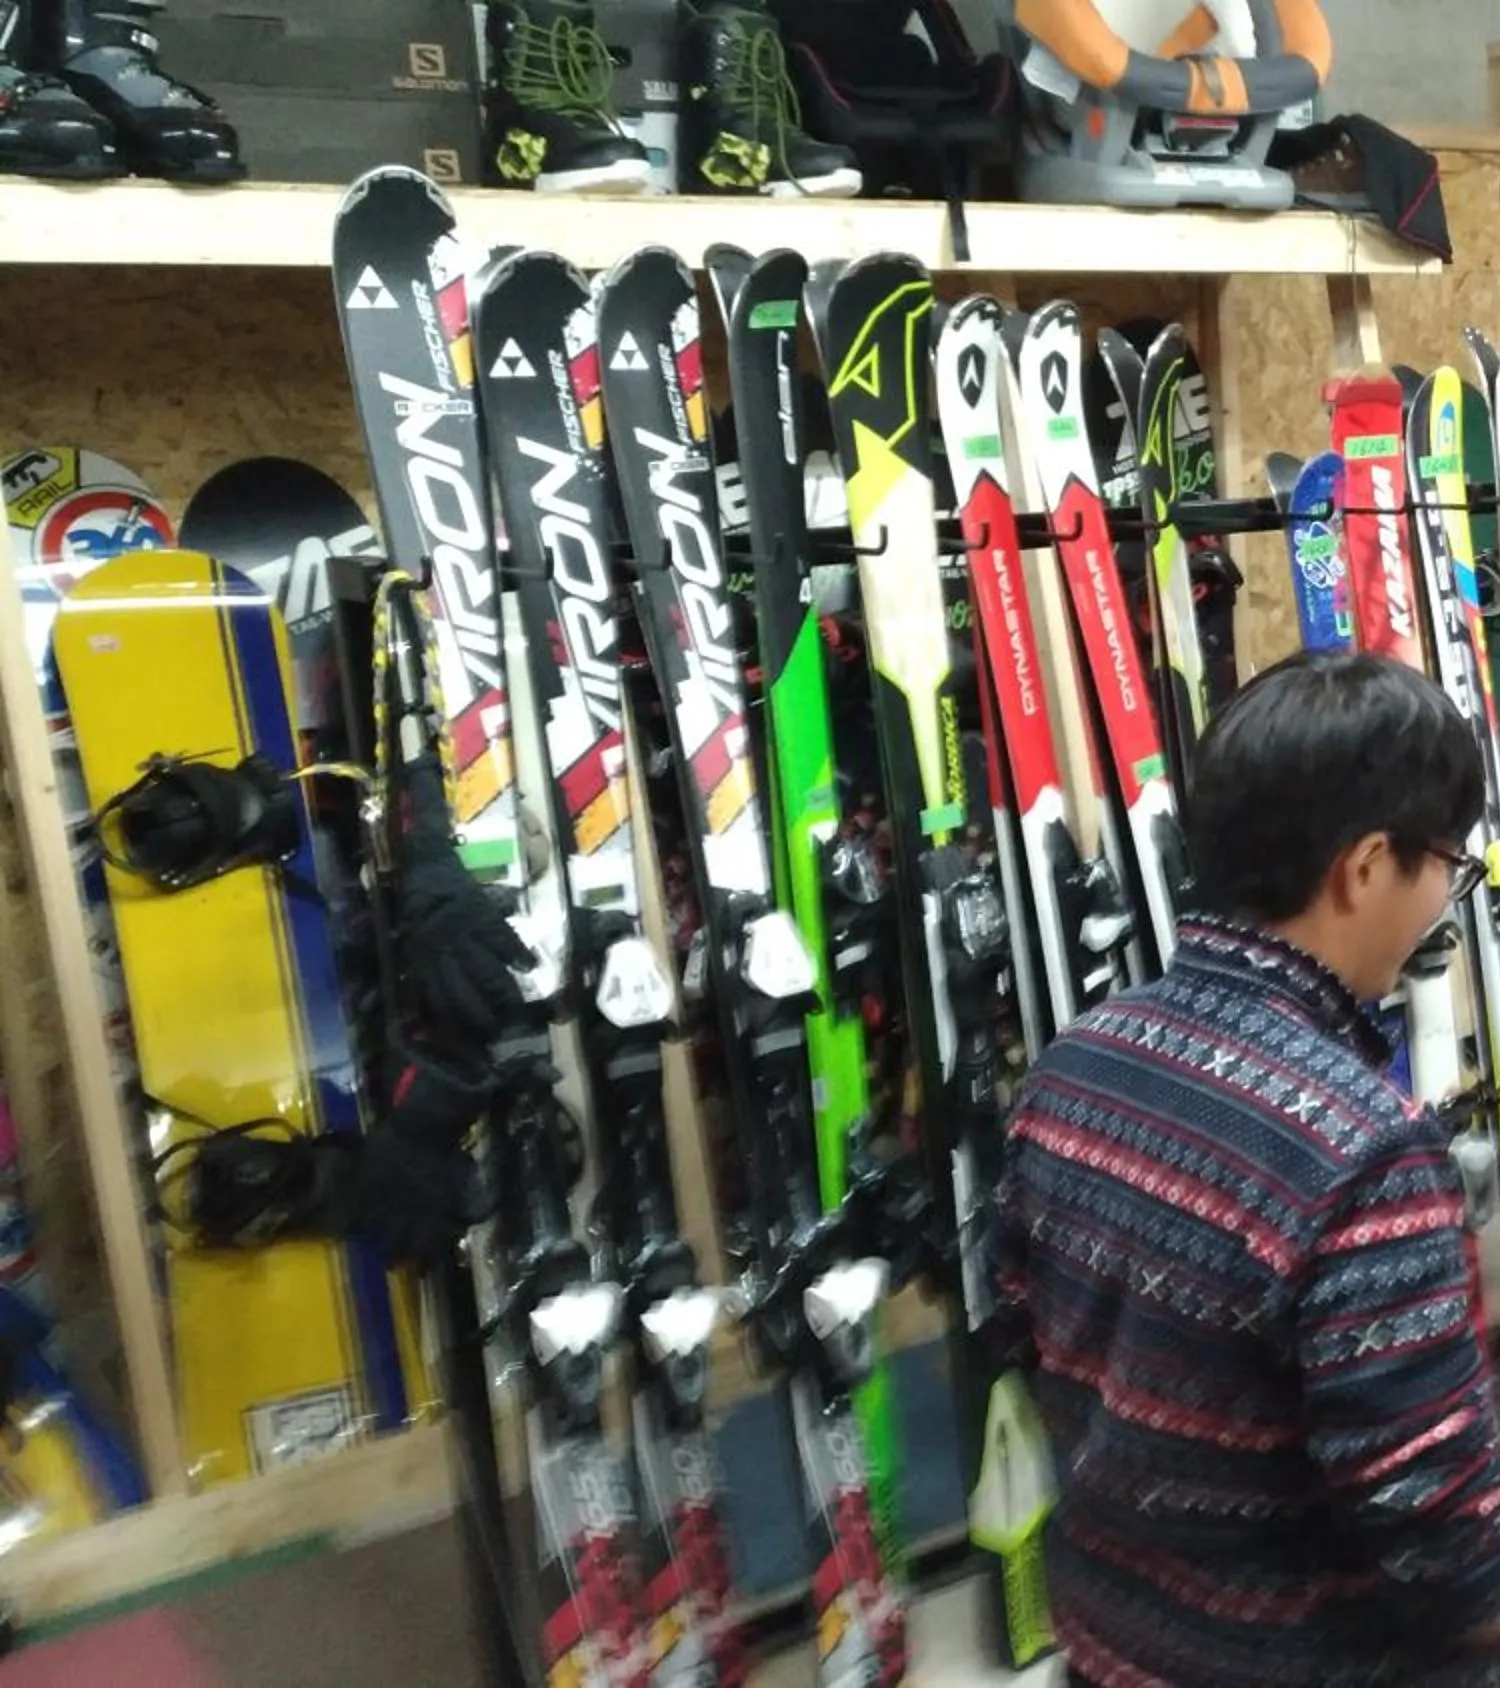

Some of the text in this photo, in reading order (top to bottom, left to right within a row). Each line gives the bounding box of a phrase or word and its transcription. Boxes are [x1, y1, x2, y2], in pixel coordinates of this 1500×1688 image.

[411, 279, 456, 393] FISCHER
[395, 401, 472, 415] RCKER
[548, 349, 587, 454] FISCHER
[655, 342, 694, 446] FISCHER
[1370, 464, 1413, 640] KAZAMA
